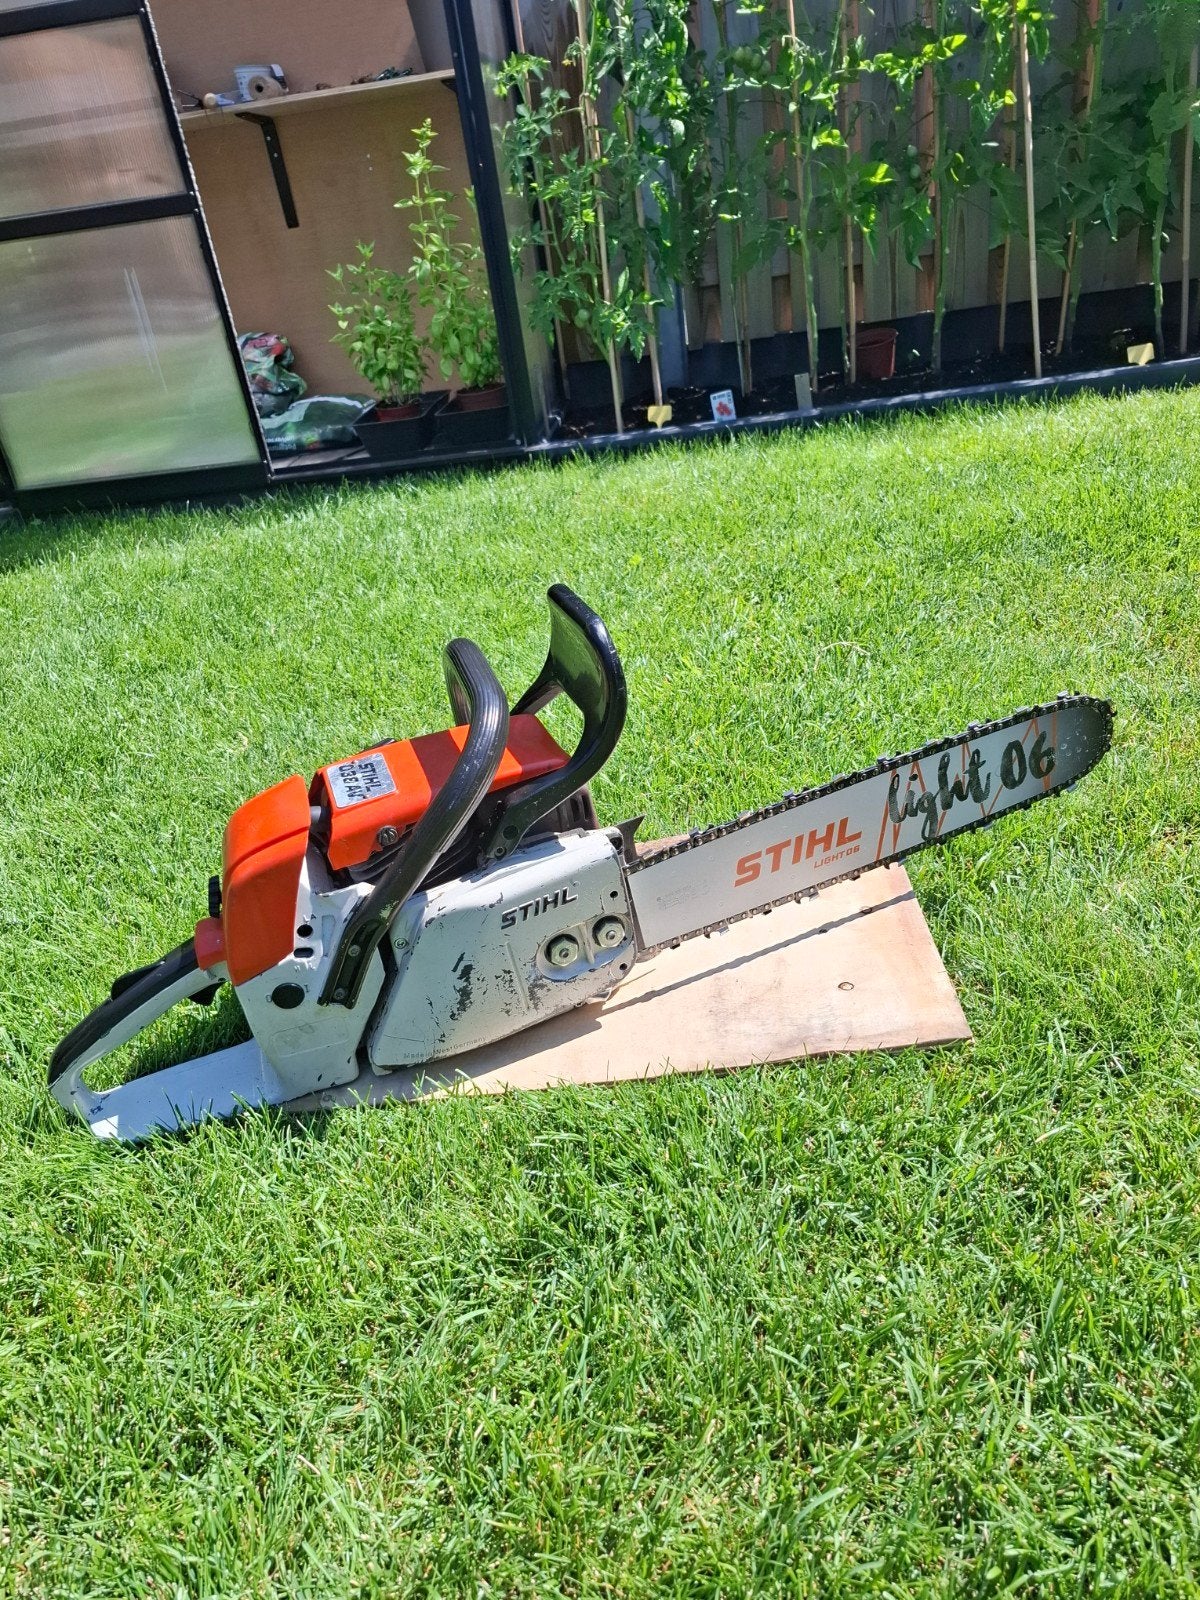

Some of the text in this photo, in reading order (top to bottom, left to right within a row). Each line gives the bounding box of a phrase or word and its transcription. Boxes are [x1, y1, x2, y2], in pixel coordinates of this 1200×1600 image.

[338, 764, 365, 798] 038 AV
[358, 762, 381, 792] STIHL
[888, 731, 1056, 842] light 06
[734, 816, 862, 887] STIHL
[813, 852, 846, 869] LIGHT
[501, 886, 578, 930] STIHL
[403, 1051, 425, 1059] Made
[433, 1045, 453, 1055] West
[453, 1036, 486, 1050] Germany
